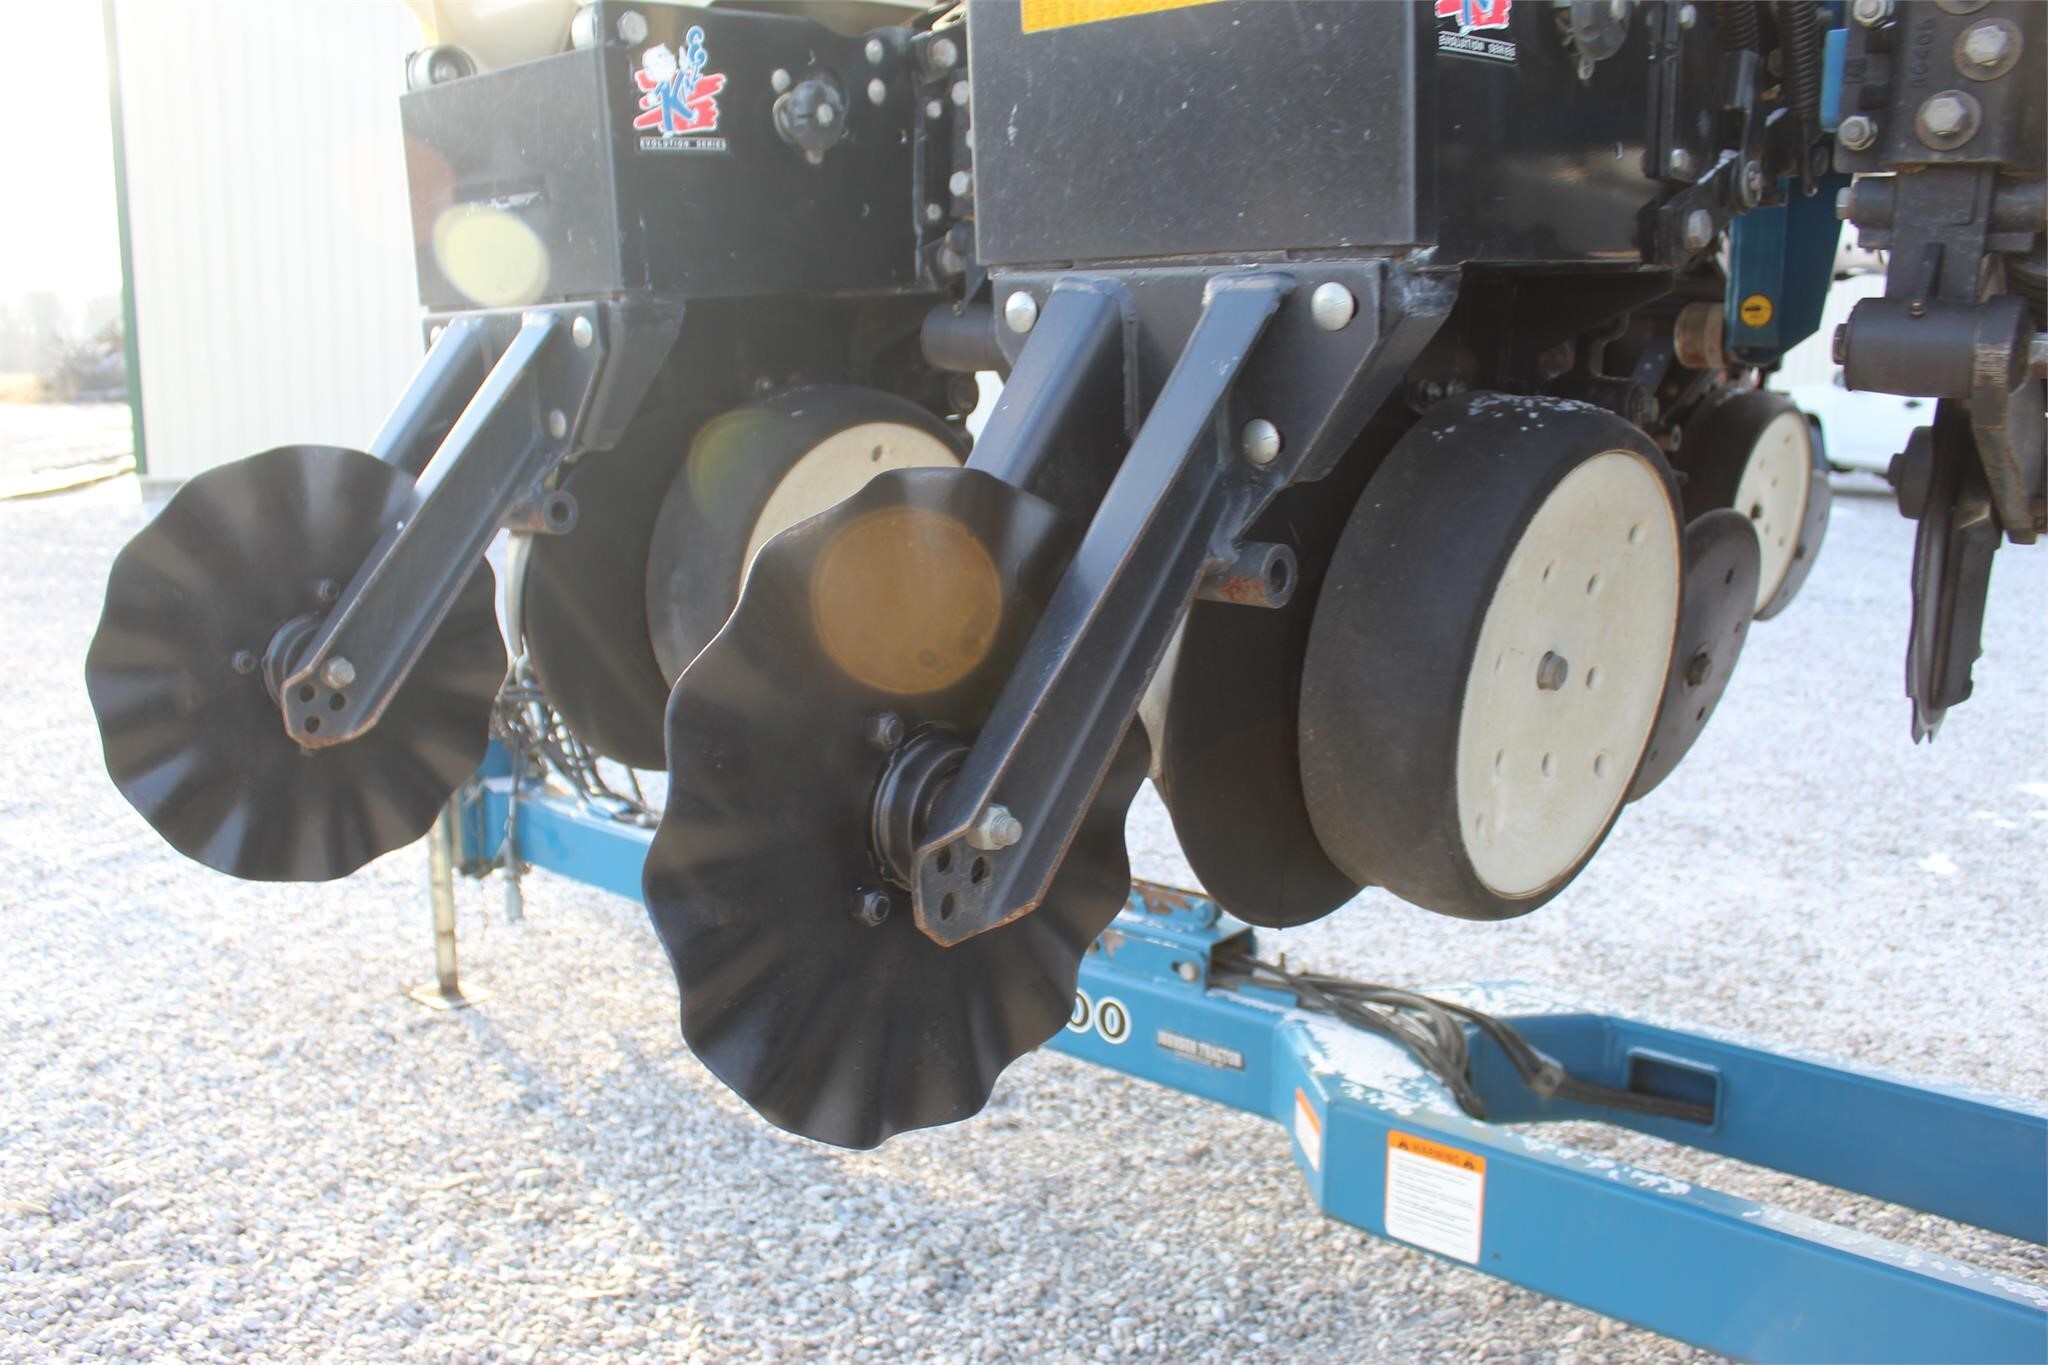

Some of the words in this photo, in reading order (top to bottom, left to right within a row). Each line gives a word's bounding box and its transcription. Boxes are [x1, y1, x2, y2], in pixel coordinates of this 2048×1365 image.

[1438, 34, 1485, 51] EVOLUTION
[1488, 43, 1516, 57] SERIES
[640, 139, 689, 149] EVOLUTION
[696, 140, 726, 149] SERIES
